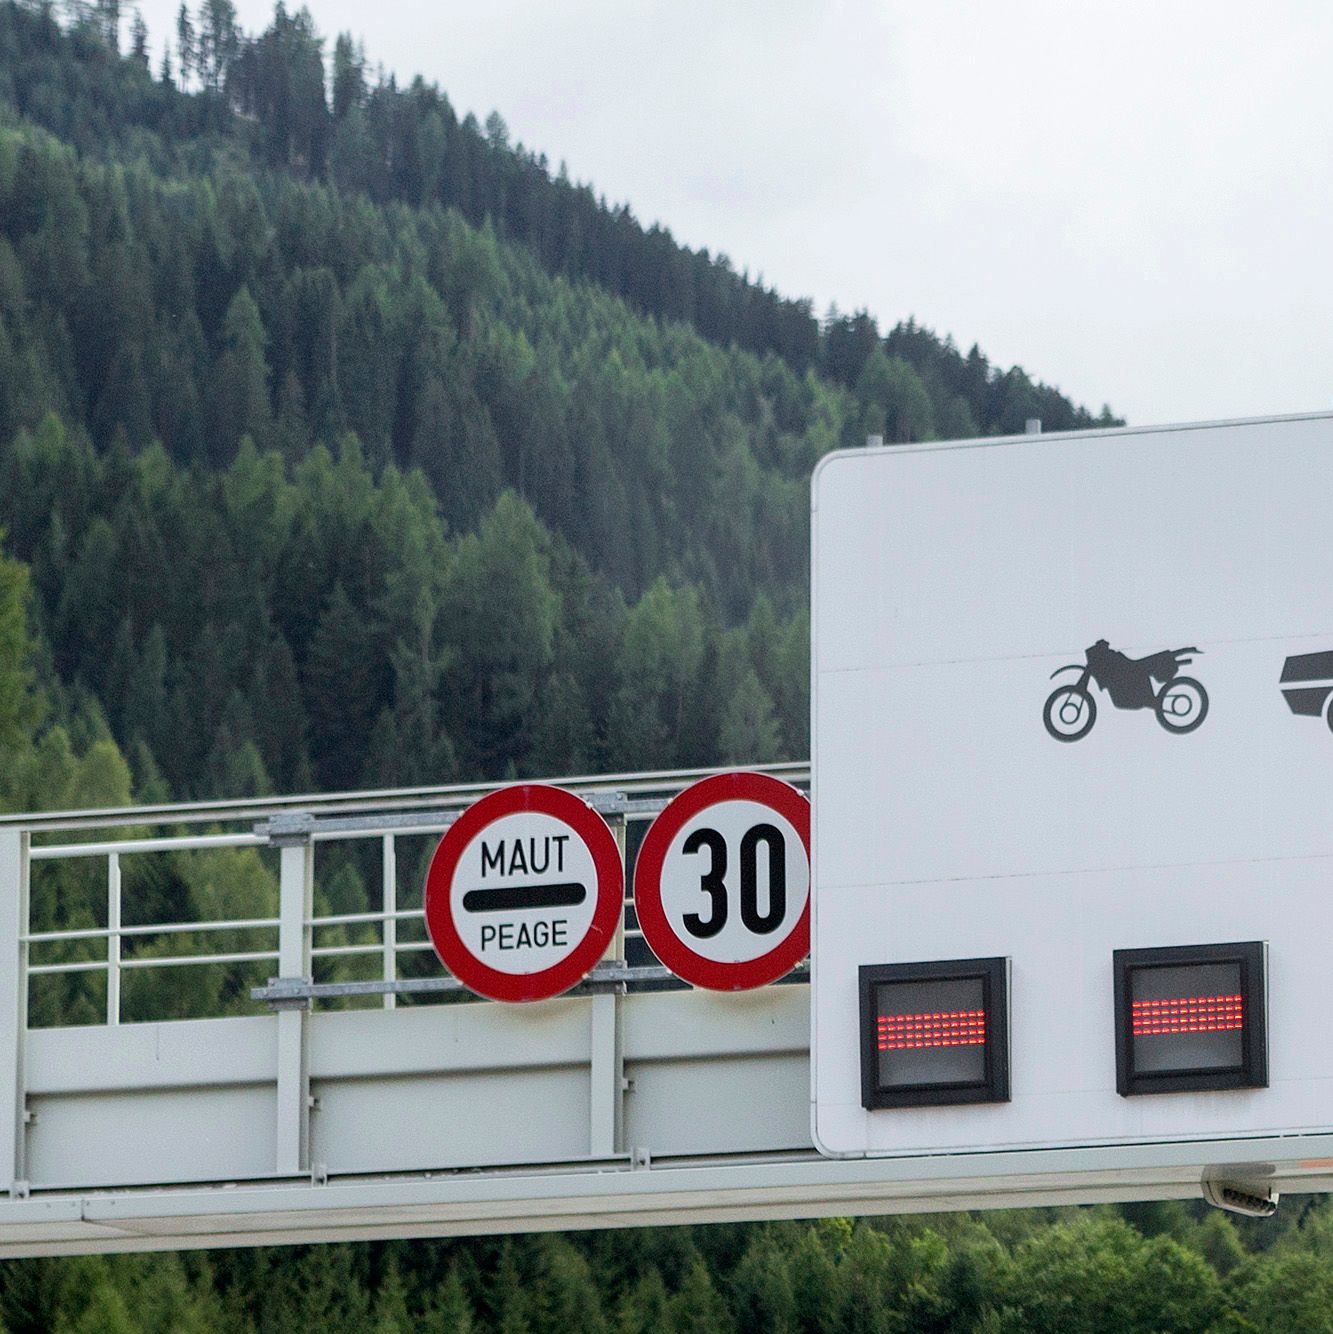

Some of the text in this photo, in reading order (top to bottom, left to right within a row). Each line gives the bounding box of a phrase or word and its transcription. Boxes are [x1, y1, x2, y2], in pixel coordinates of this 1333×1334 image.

[481, 835, 570, 878] MAUT
[682, 823, 786, 939] 30
[481, 919, 568, 951] PEAGE
